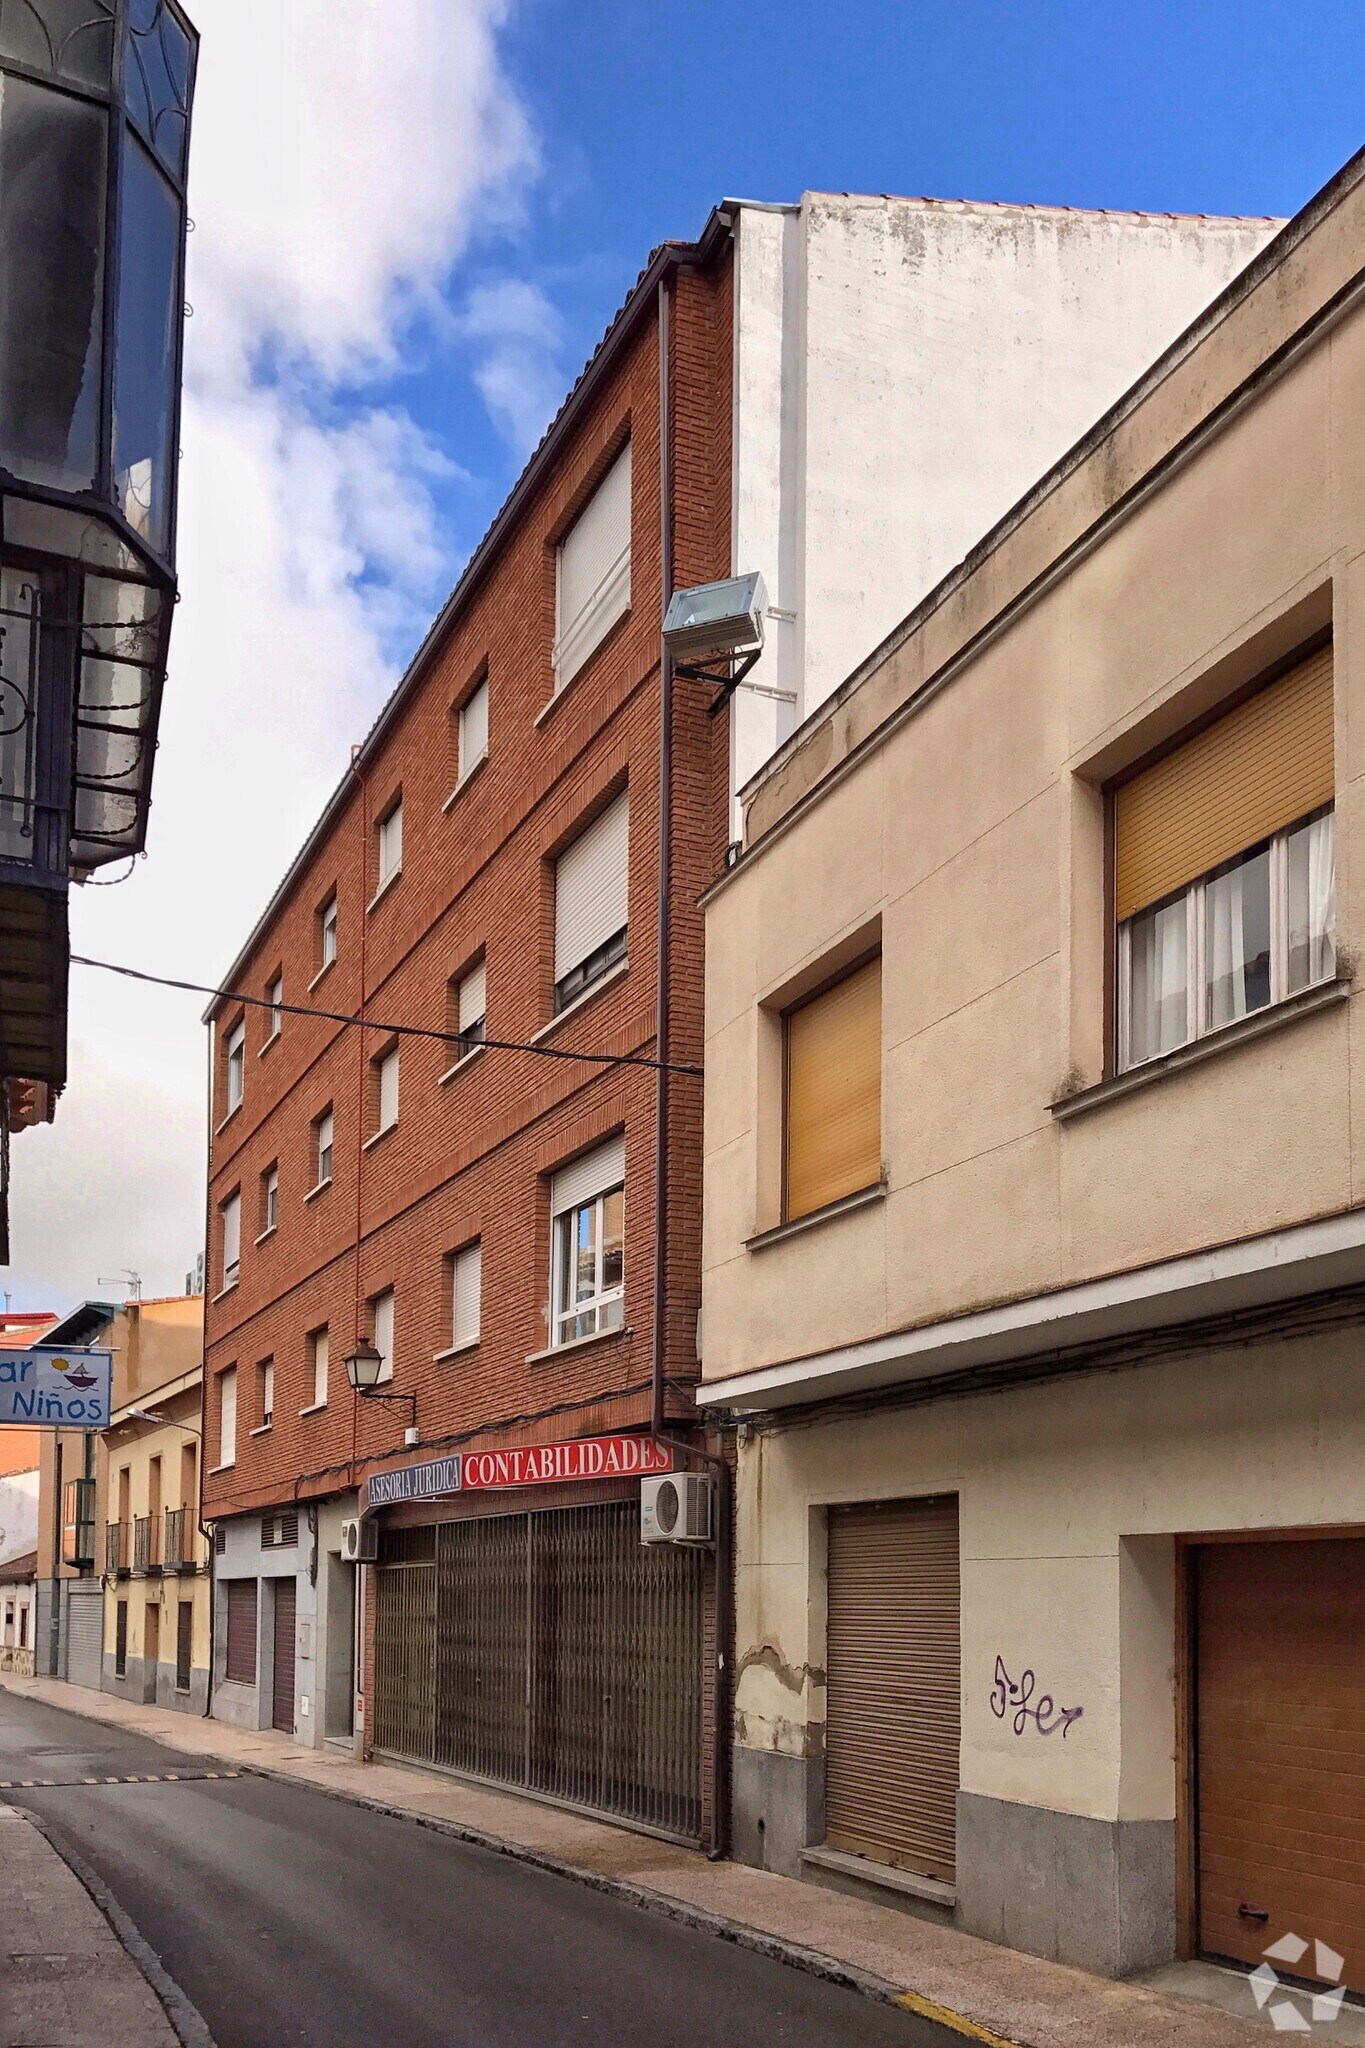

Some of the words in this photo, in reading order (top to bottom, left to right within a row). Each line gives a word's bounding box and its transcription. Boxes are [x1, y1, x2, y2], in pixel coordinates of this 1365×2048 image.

[12, 1389, 103, 1420] Niños
[370, 1470, 411, 1503] ASESORIA
[413, 1459, 459, 1495] JURIDICA
[464, 1437, 669, 1486] CONTABILIDADES
